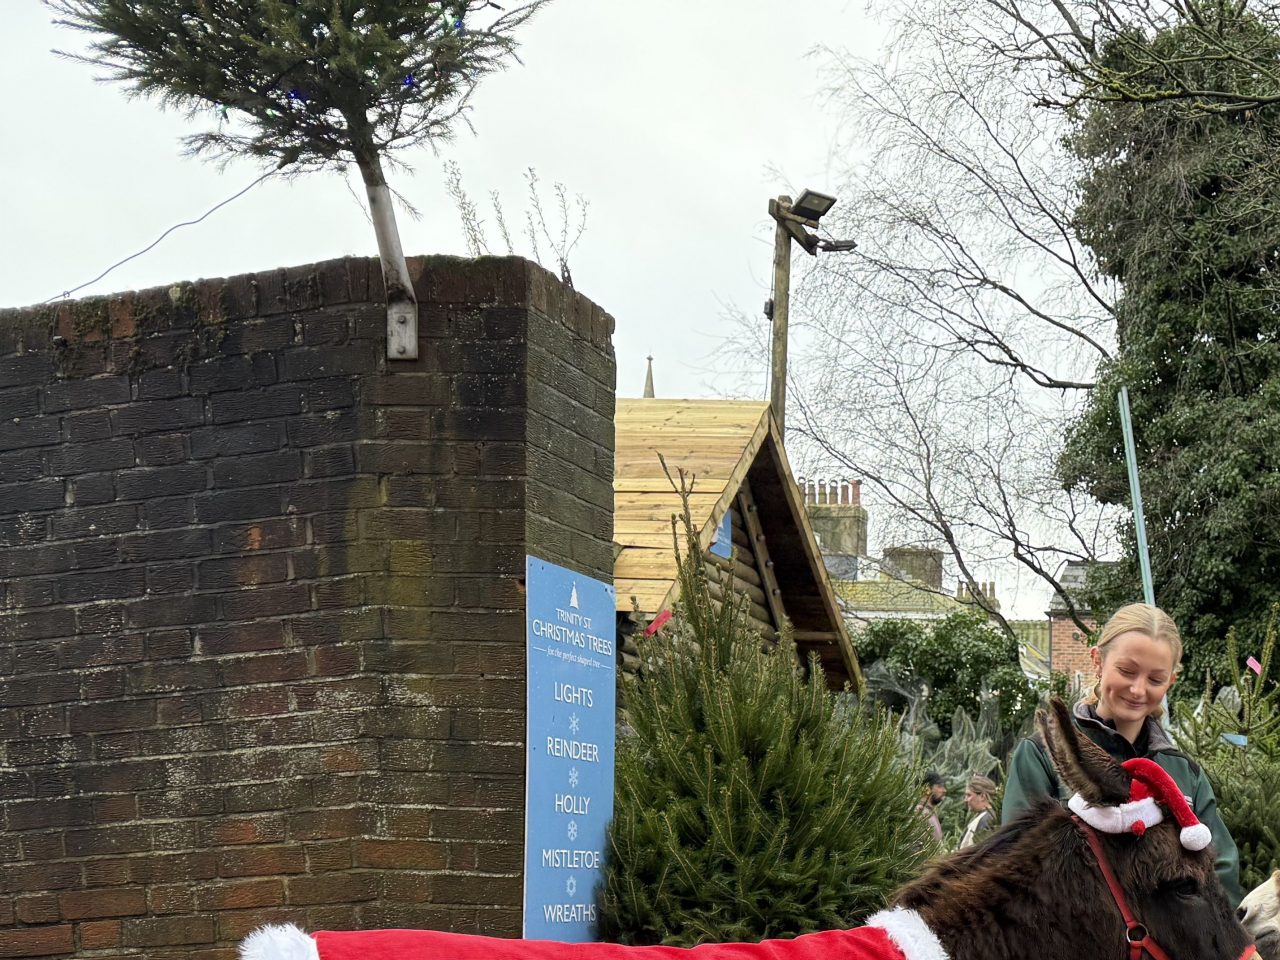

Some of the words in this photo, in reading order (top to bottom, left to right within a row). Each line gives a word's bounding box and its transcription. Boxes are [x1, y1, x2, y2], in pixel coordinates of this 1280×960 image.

[555, 608, 582, 626] TRINITY
[532, 619, 585, 648] CHRISTMAS
[587, 635, 612, 656] TREES
[554, 682, 593, 708] LIGHTS
[547, 736, 599, 763] REINDEER
[555, 793, 590, 816] HOLLY
[542, 848, 599, 870] MISTLETOE
[543, 903, 596, 924] WREATHS
